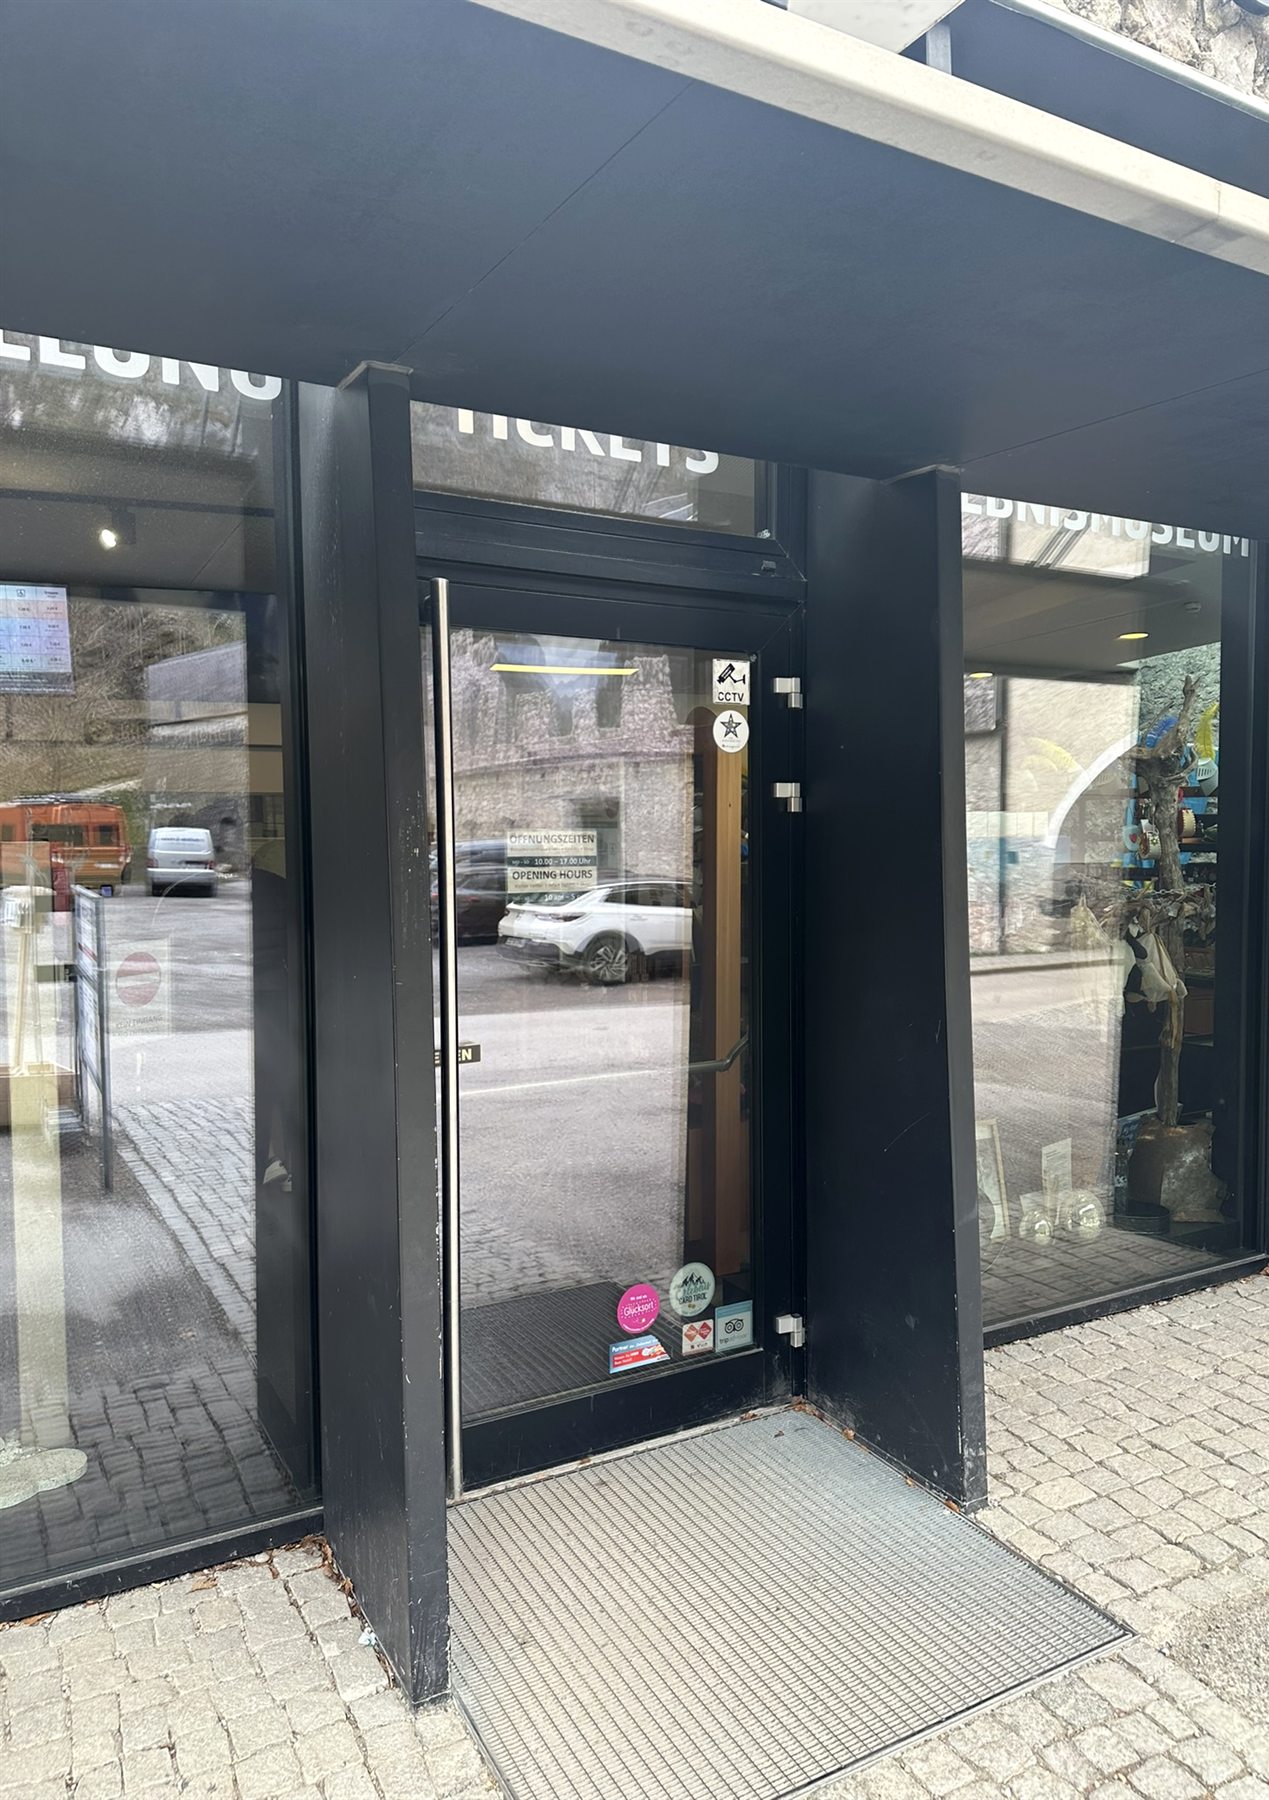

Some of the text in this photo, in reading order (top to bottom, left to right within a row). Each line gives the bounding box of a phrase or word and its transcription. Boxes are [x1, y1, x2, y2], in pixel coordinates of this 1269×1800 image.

[717, 691, 744, 702] CCTV
[509, 832, 595, 844] ÖFFNUNGSZEITEN
[560, 857, 577, 865] 17.00
[512, 869, 593, 880] OPENING HOURS
